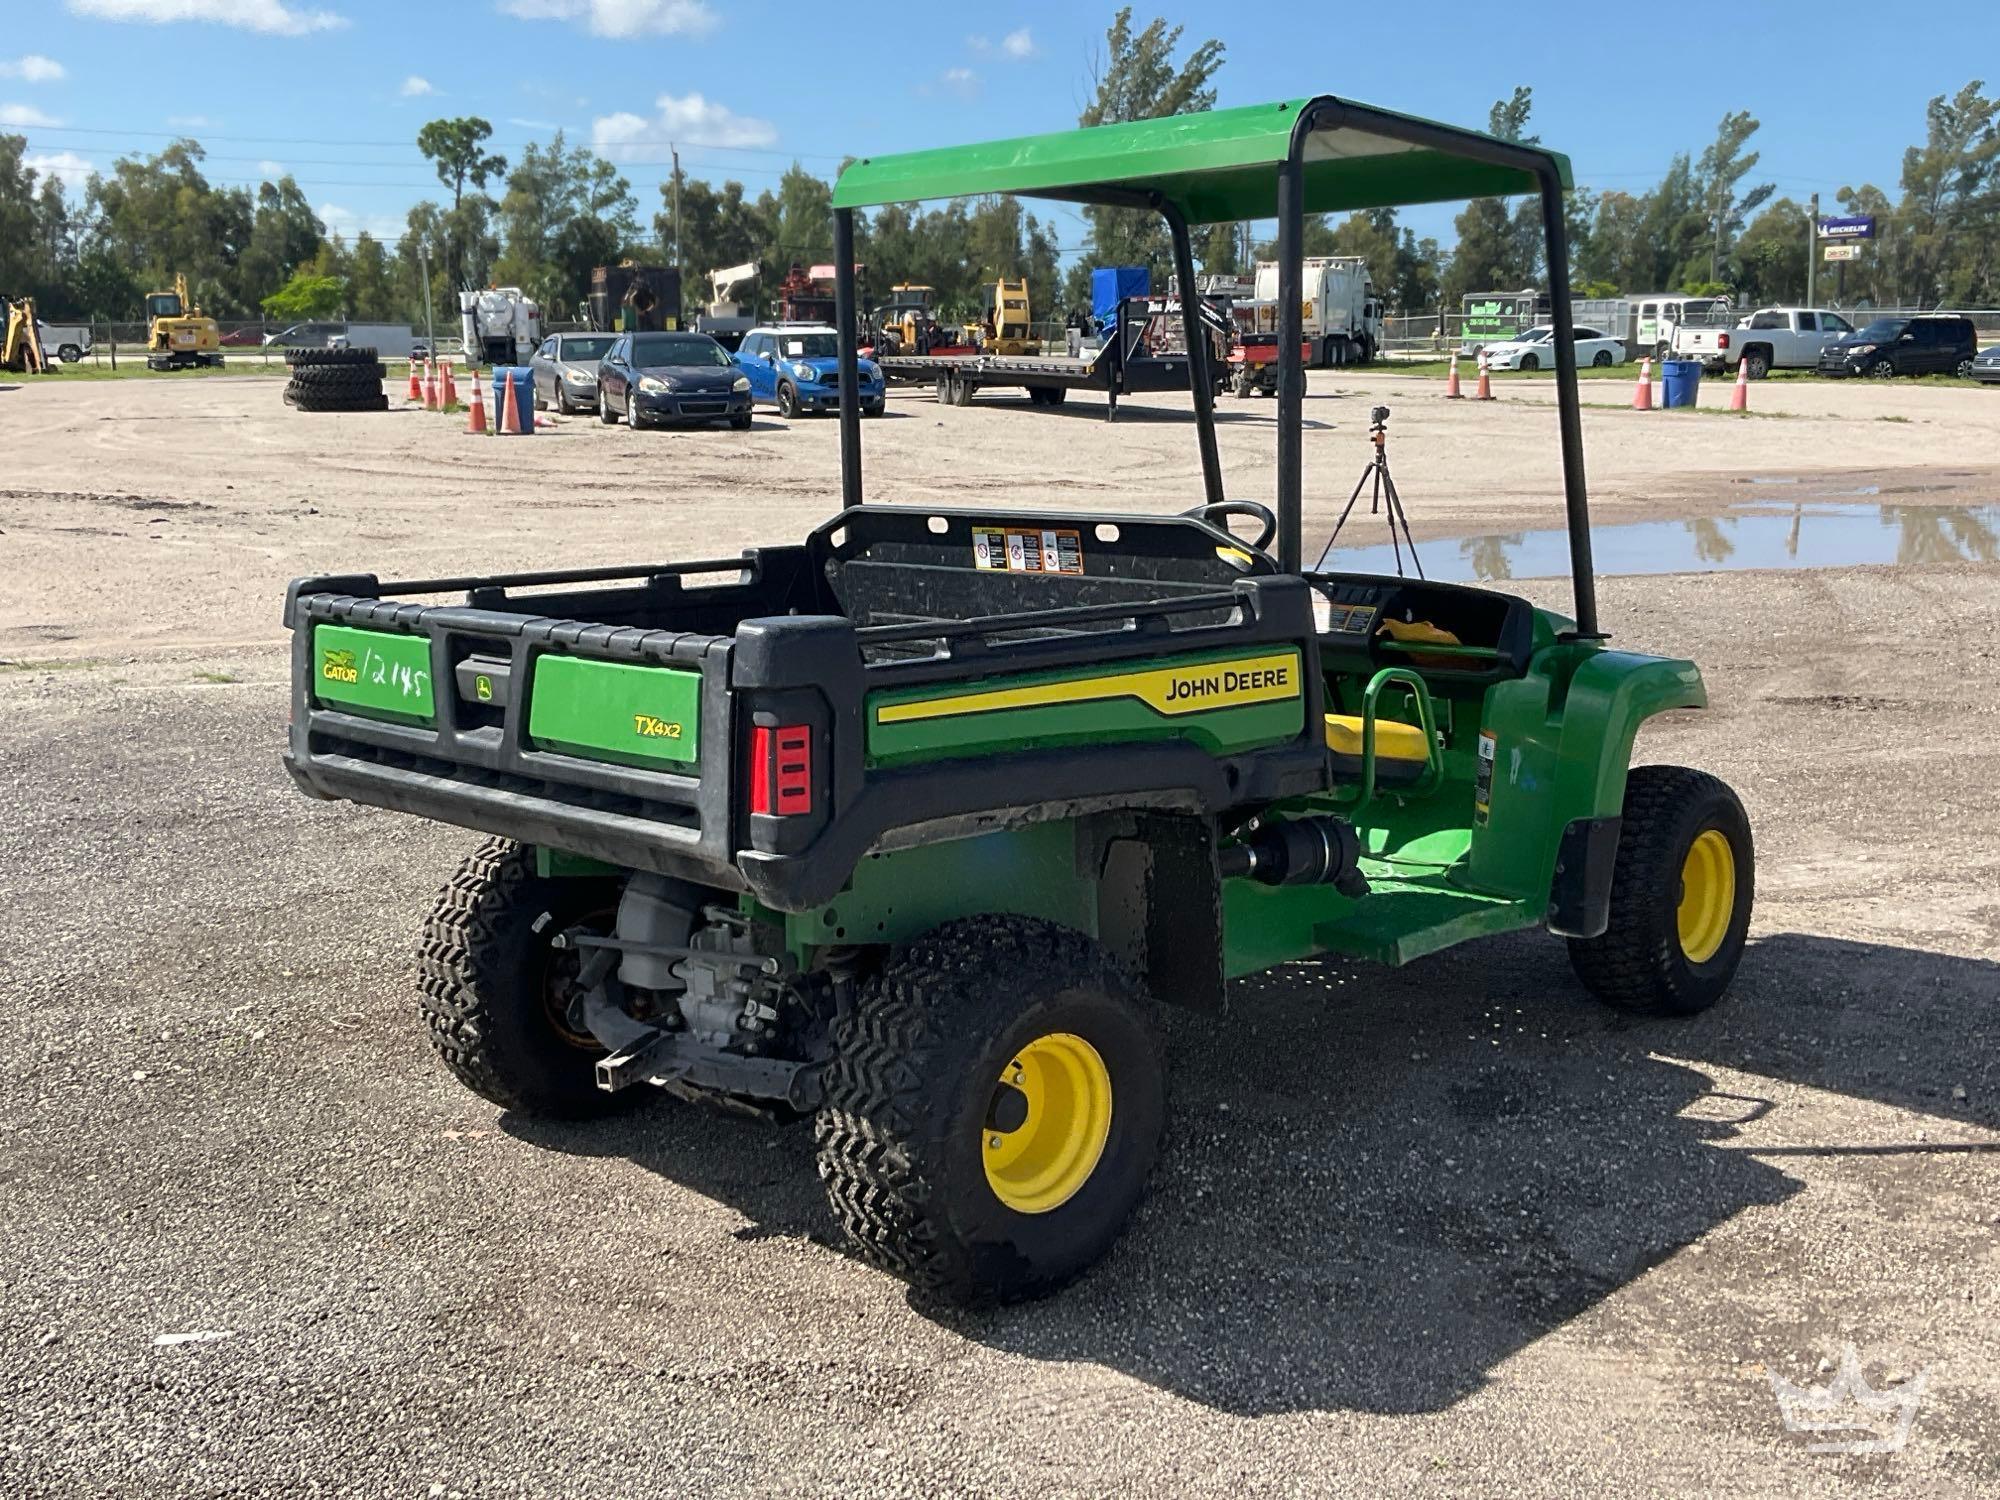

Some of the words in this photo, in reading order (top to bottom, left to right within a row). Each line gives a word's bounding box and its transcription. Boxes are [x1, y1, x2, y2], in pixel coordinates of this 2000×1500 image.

[1829, 225, 1868, 233] MICHELIN
[323, 663, 358, 684] GATOR
[1166, 677, 1219, 701] JOHN
[1224, 668, 1288, 693] DEERE
